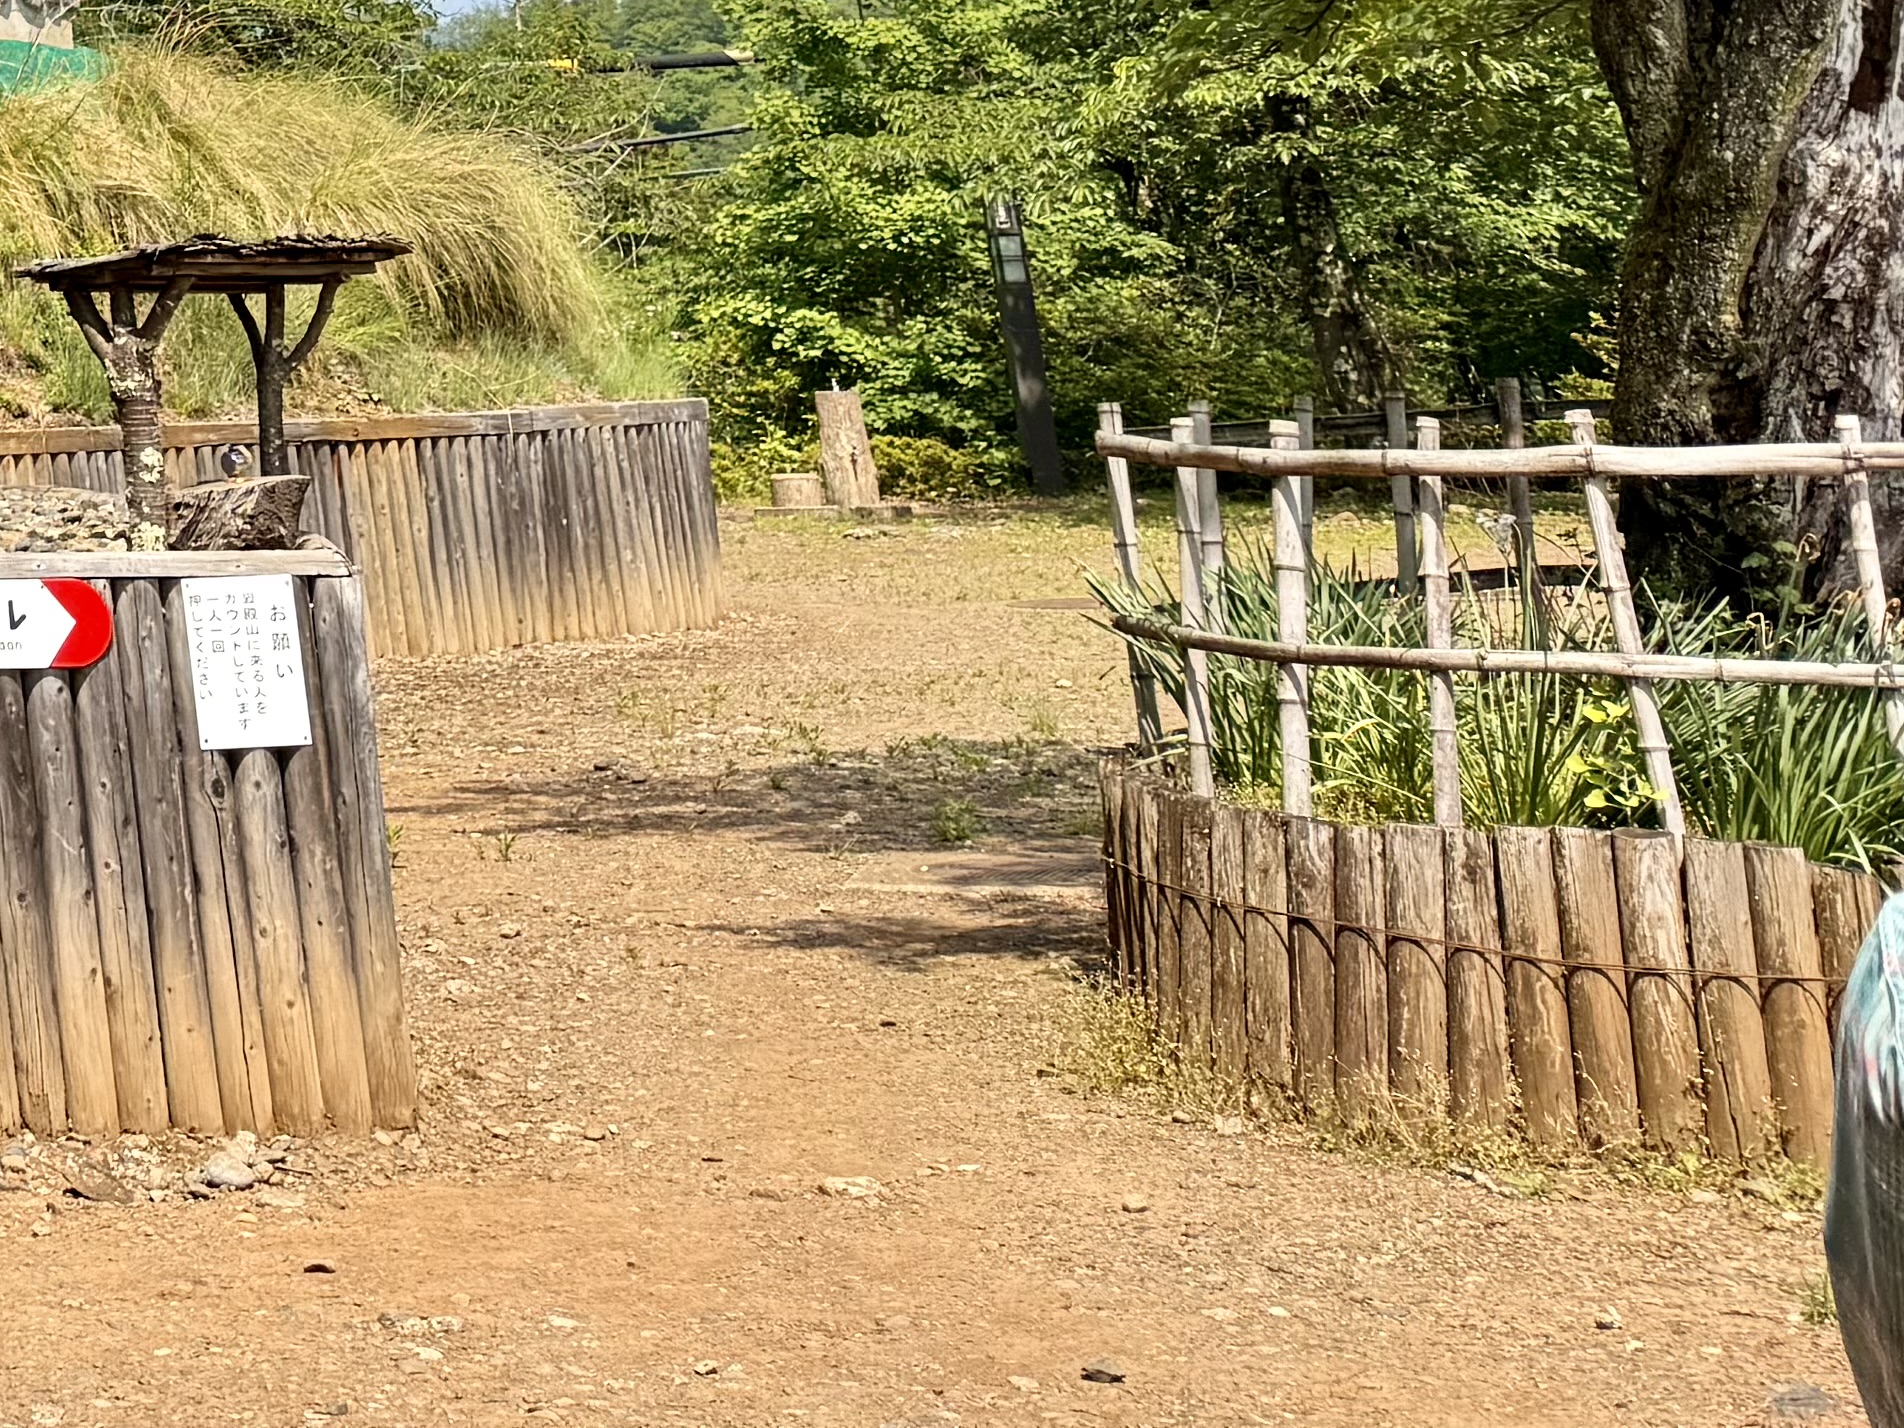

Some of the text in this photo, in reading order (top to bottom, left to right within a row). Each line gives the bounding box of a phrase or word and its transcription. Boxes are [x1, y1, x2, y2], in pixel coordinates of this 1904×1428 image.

[189, 594, 213, 700] 押してください
[206, 596, 225, 653] 一人一回
[225, 593, 251, 730] カウントしています
[270, 604, 294, 678] お願い
